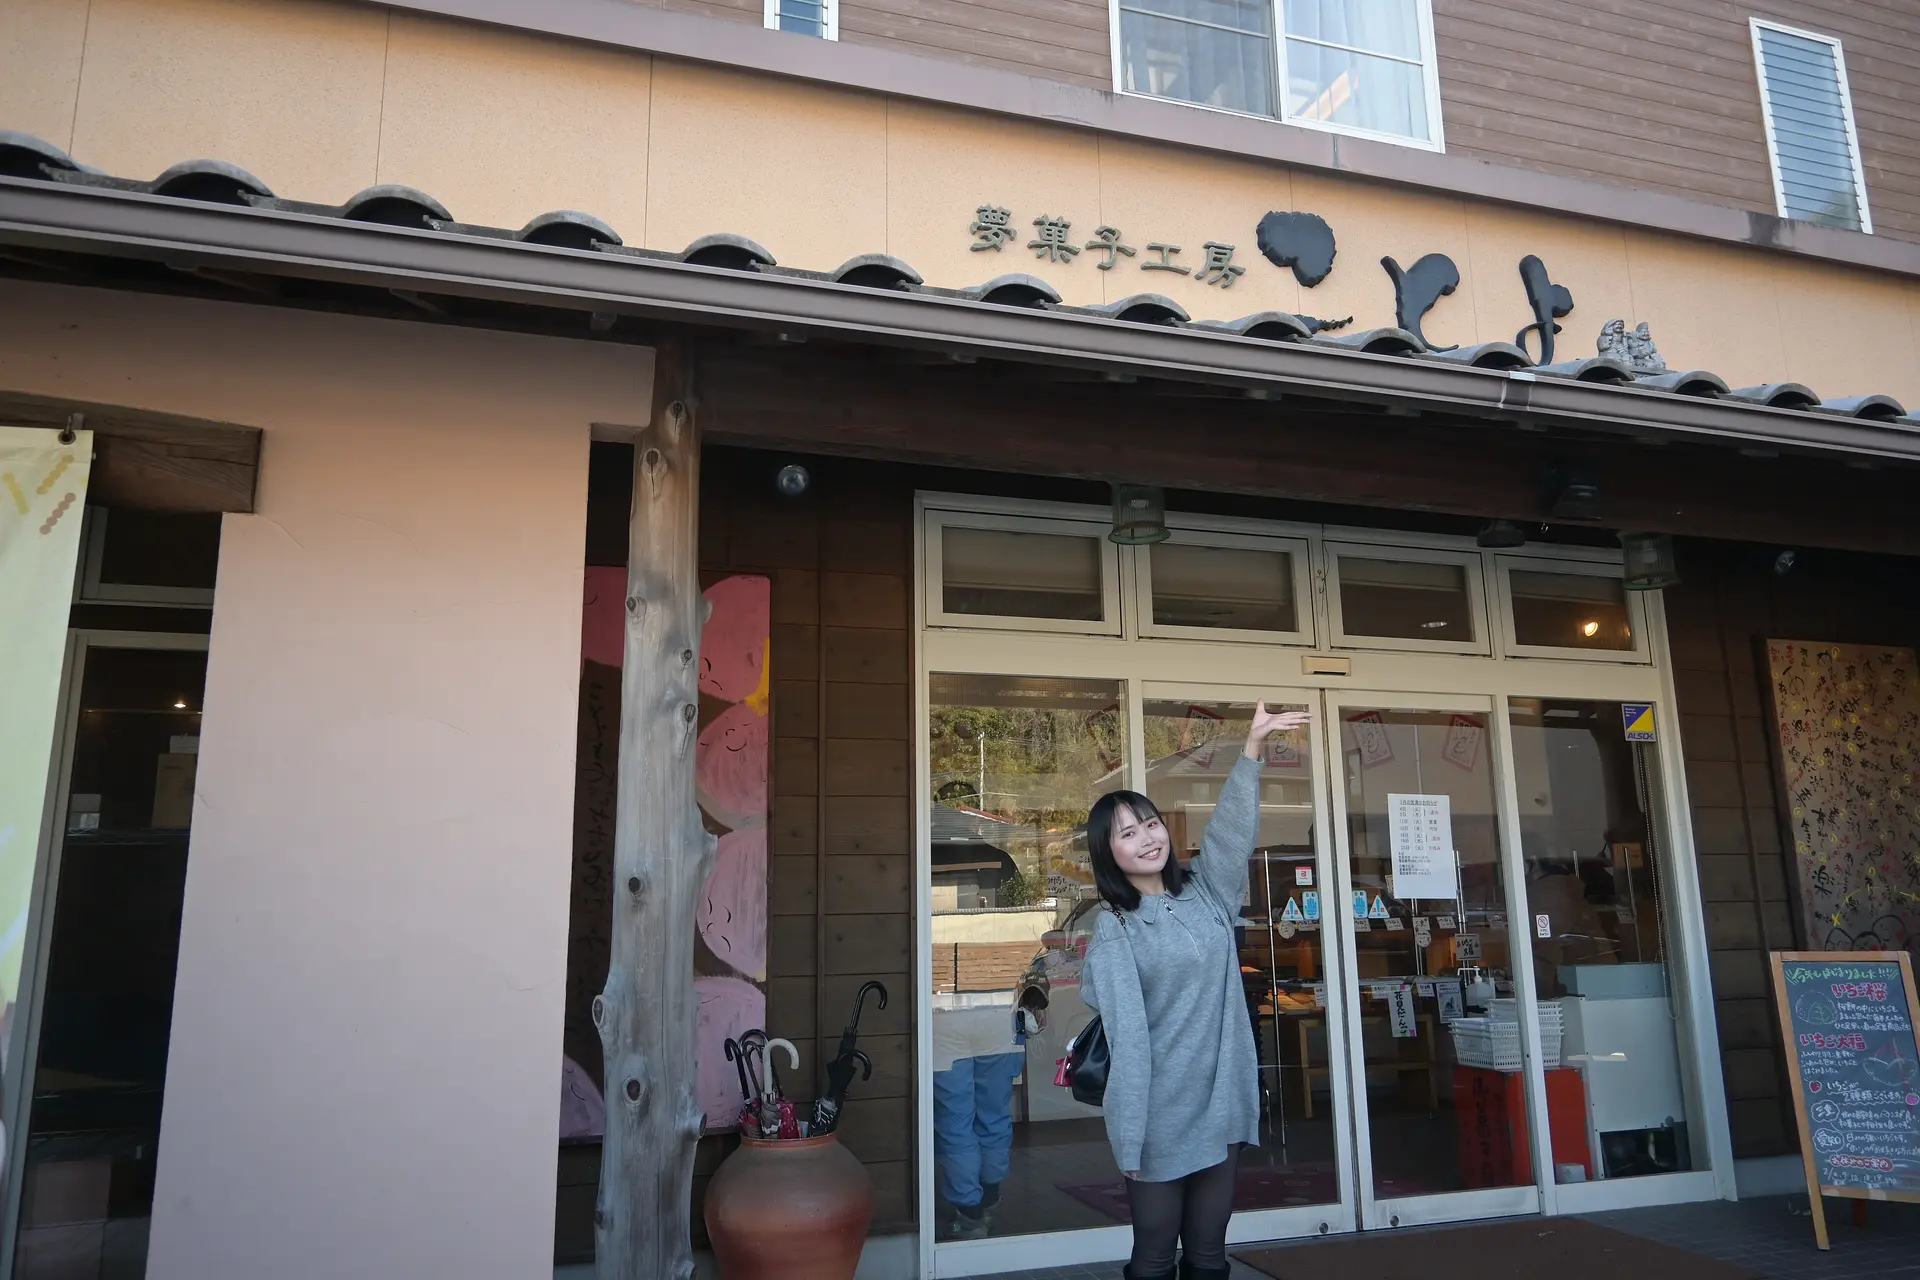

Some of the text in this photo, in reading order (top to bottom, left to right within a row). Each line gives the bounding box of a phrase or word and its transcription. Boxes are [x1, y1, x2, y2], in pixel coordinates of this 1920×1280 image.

[970, 204, 1246, 289] 夢菓子工房
[1627, 732, 1654, 740] ALSOK
[1831, 983, 1888, 1001] いちご桜
[1394, 991, 1408, 1034] 花見だんご
[1799, 1032, 1866, 1050] いちご大福
